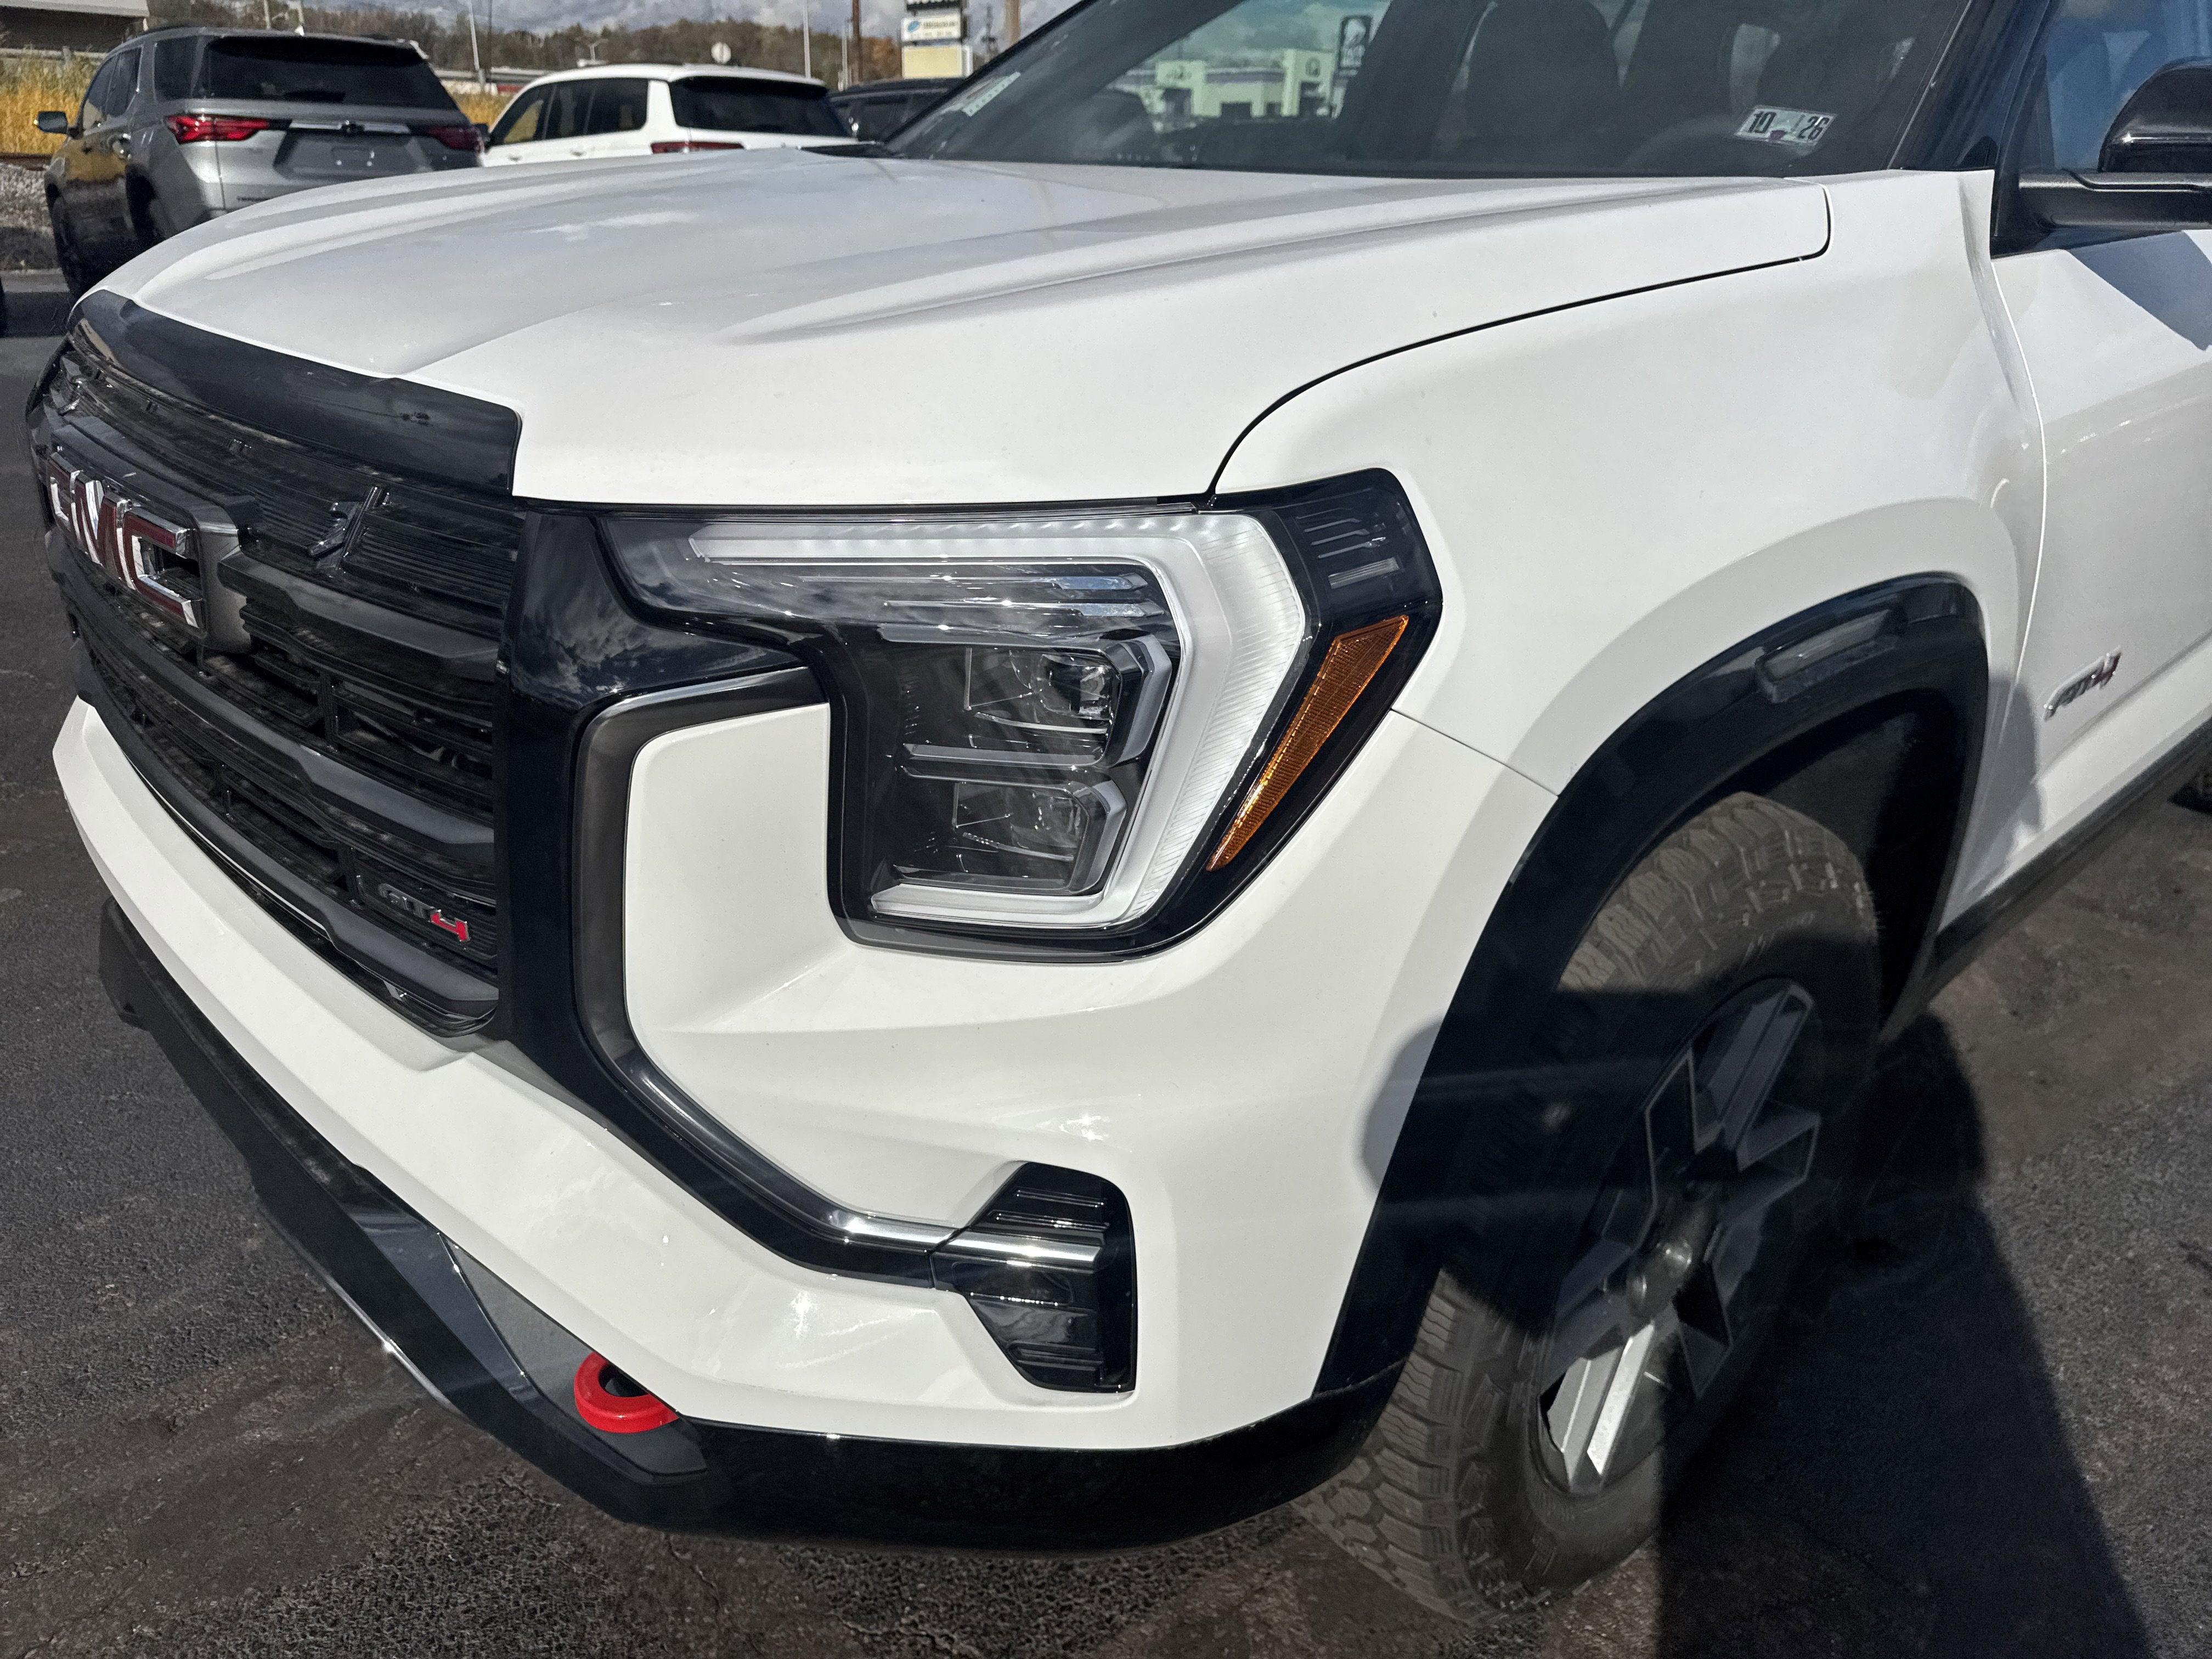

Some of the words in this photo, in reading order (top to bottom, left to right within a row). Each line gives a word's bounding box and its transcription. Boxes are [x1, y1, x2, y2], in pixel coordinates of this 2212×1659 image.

[1747, 110, 1777, 134] 10
[1798, 116, 1830, 140] 26
[47, 452, 202, 630] GMC
